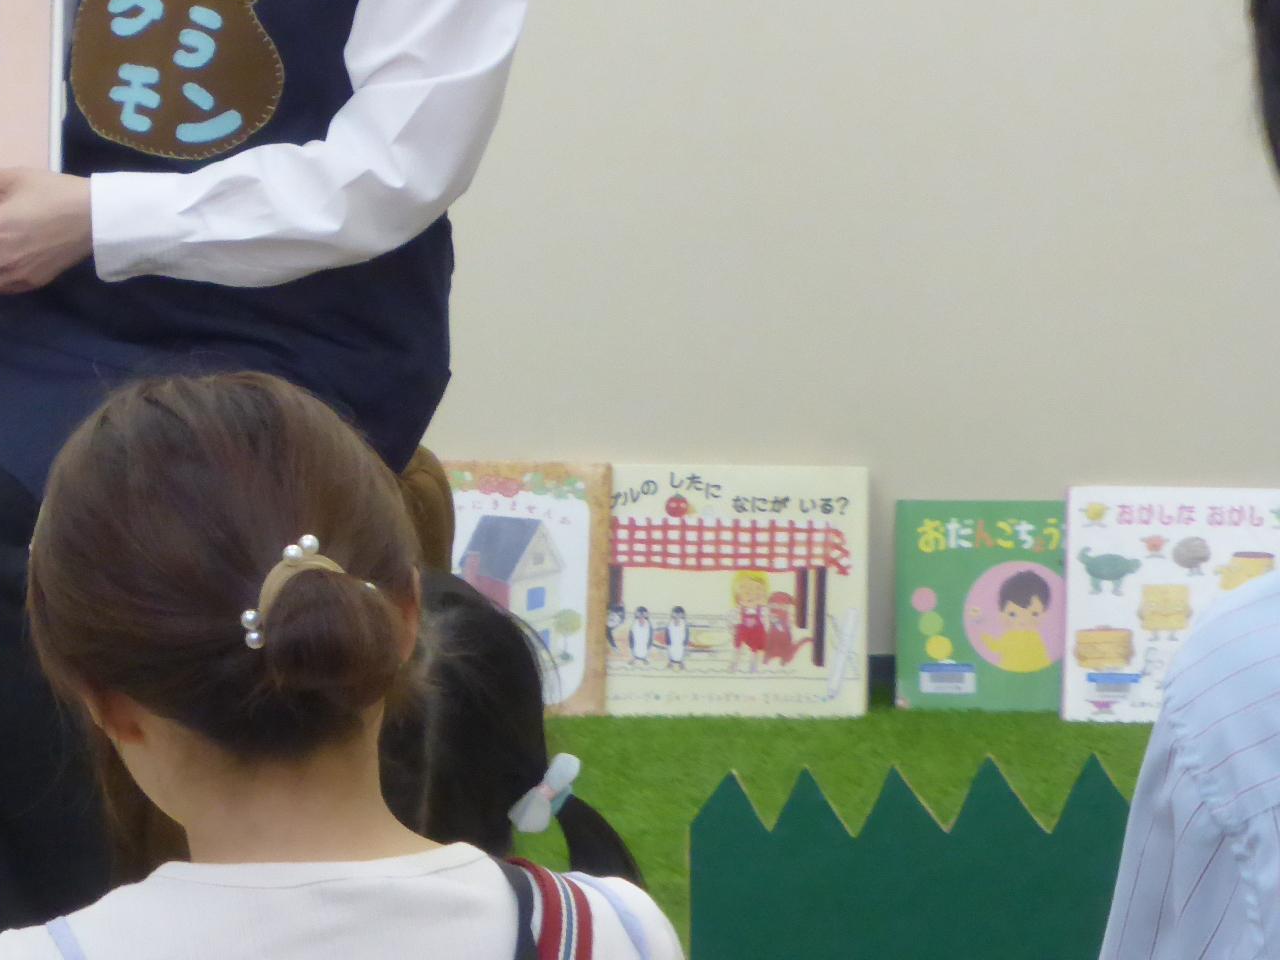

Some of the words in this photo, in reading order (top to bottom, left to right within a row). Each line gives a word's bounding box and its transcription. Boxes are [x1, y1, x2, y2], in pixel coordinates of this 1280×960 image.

[669, 471, 722, 500] したに
[731, 495, 791, 514] なにが
[916, 516, 1067, 554] おだんごちょう
